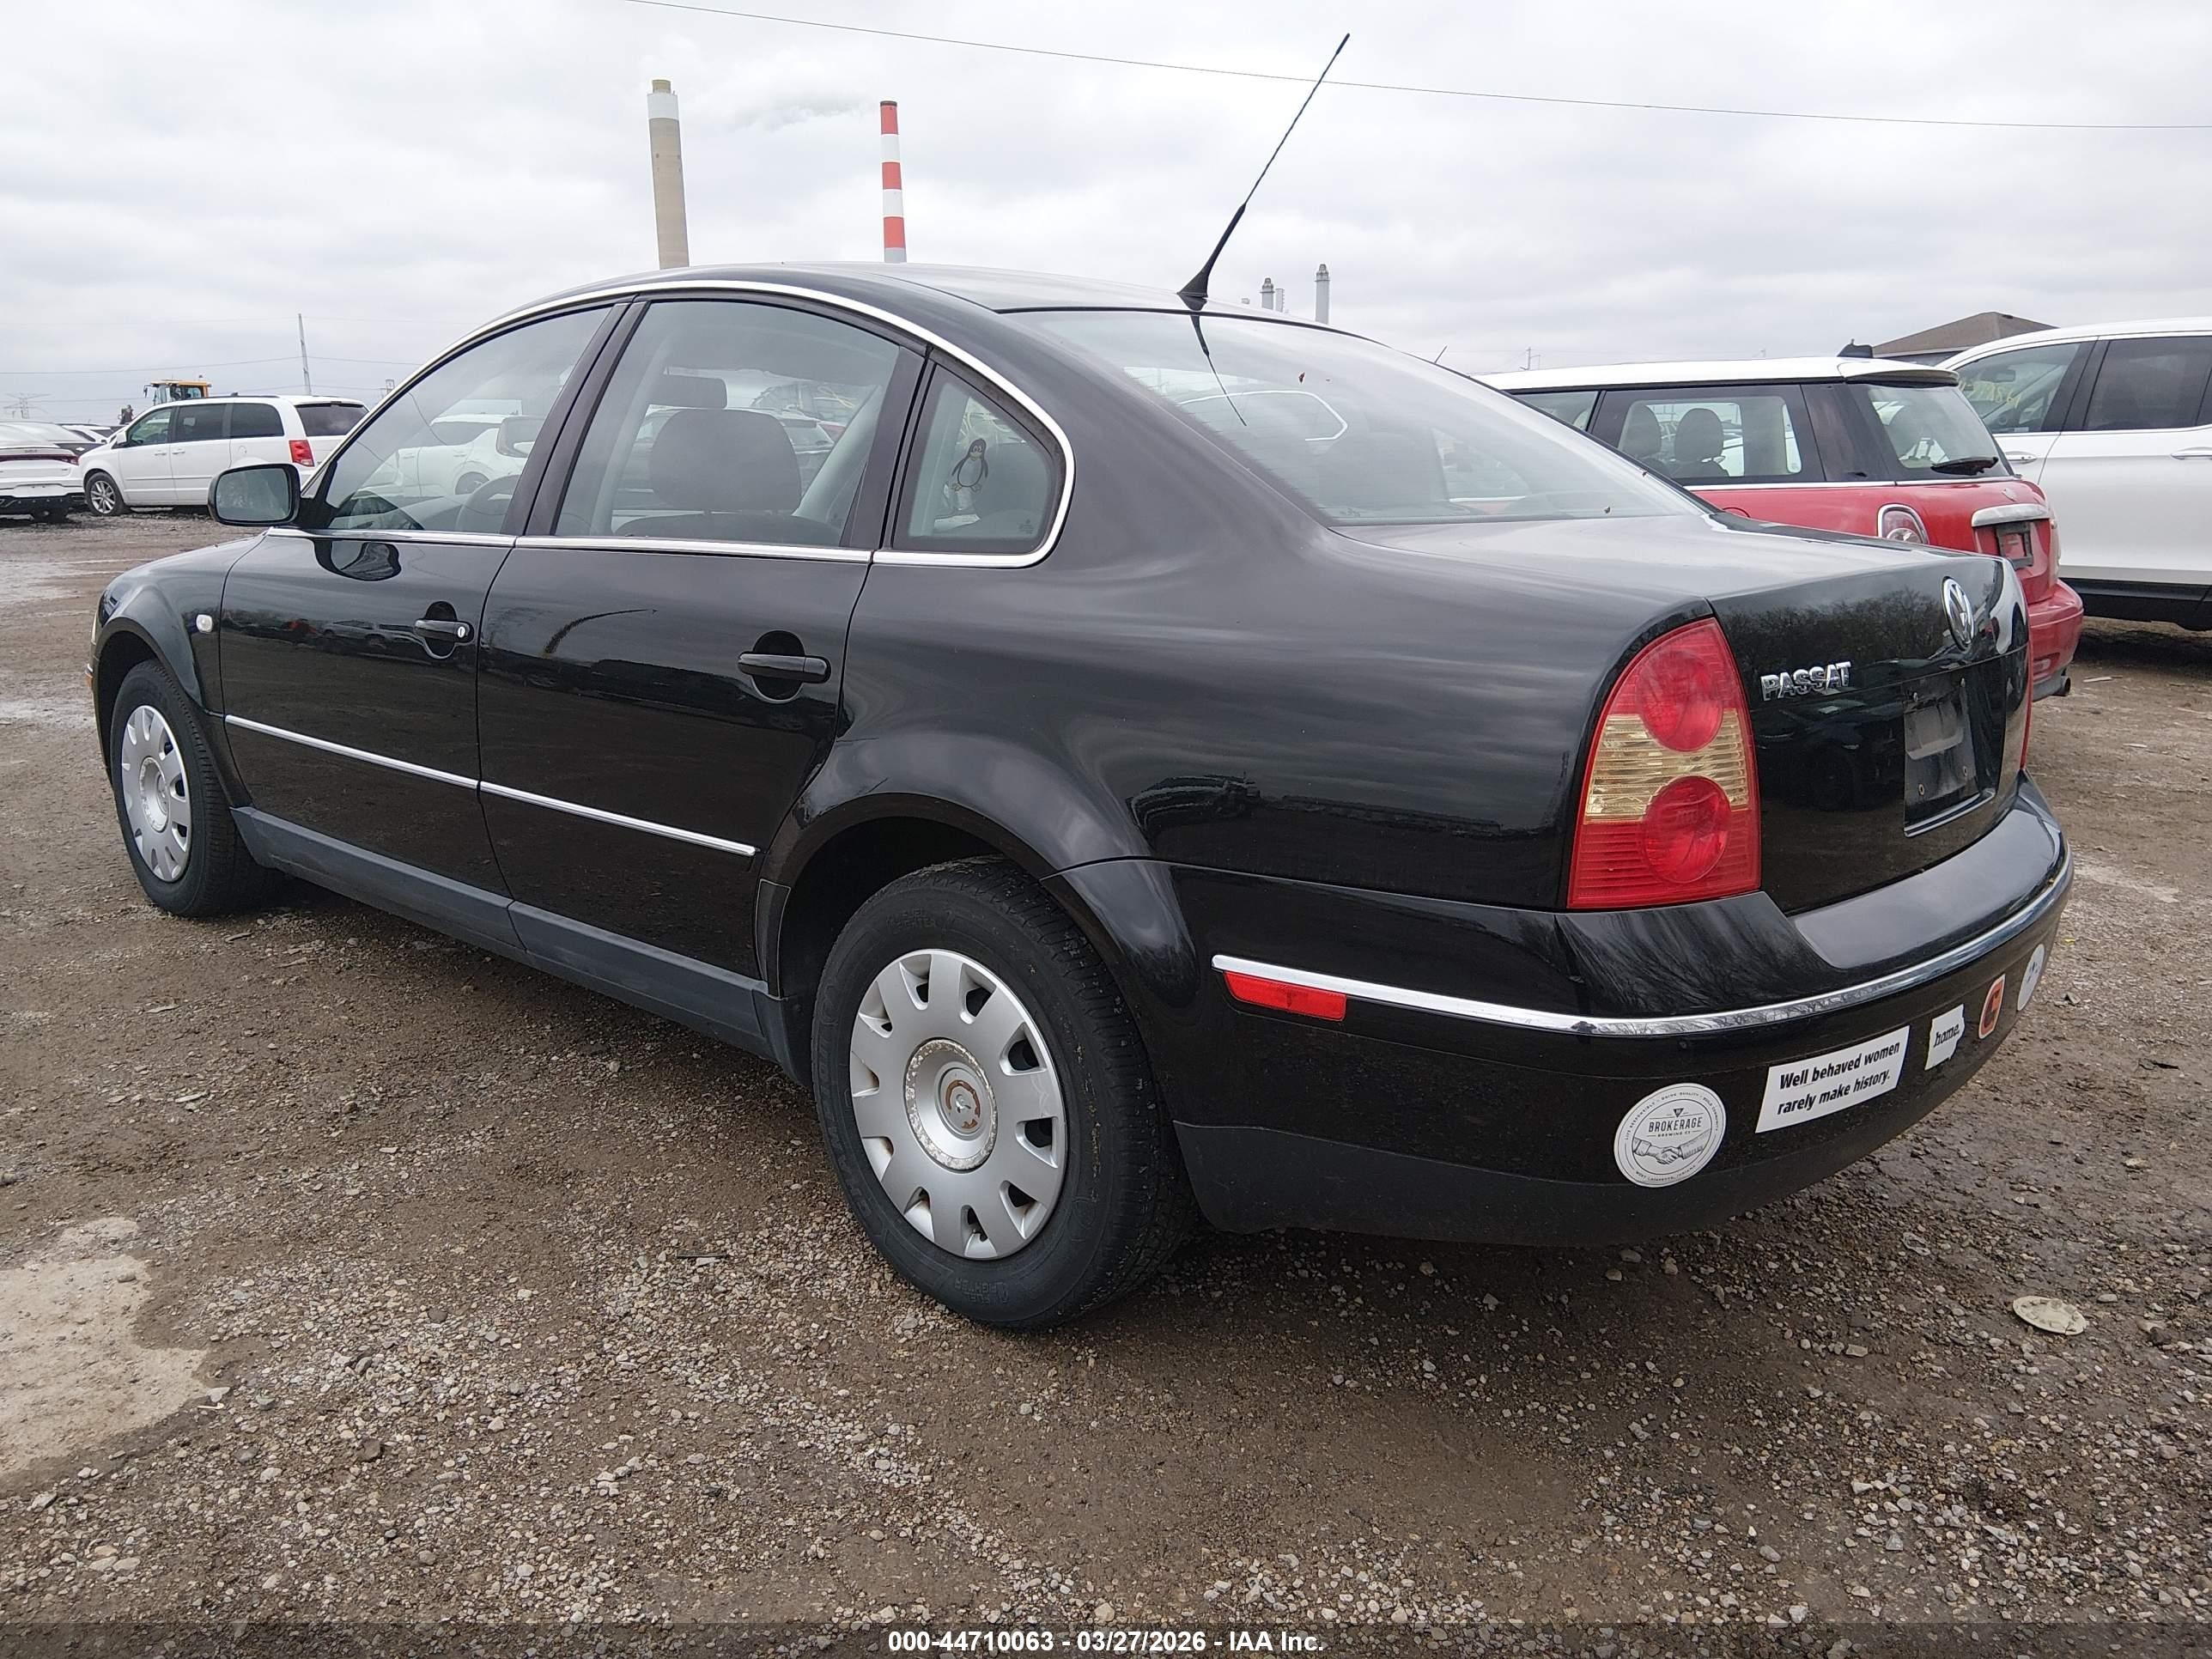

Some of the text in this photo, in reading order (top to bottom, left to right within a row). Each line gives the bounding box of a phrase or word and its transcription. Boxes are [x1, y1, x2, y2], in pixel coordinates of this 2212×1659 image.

[1760, 661, 1851, 702] PASSAT
[1933, 1024, 1960, 1048] home
[1779, 1042, 1900, 1090] Well behaved women
[1777, 1069, 1891, 1115] rarely make history.
[1648, 1116, 1703, 1133] BROKERAGE
